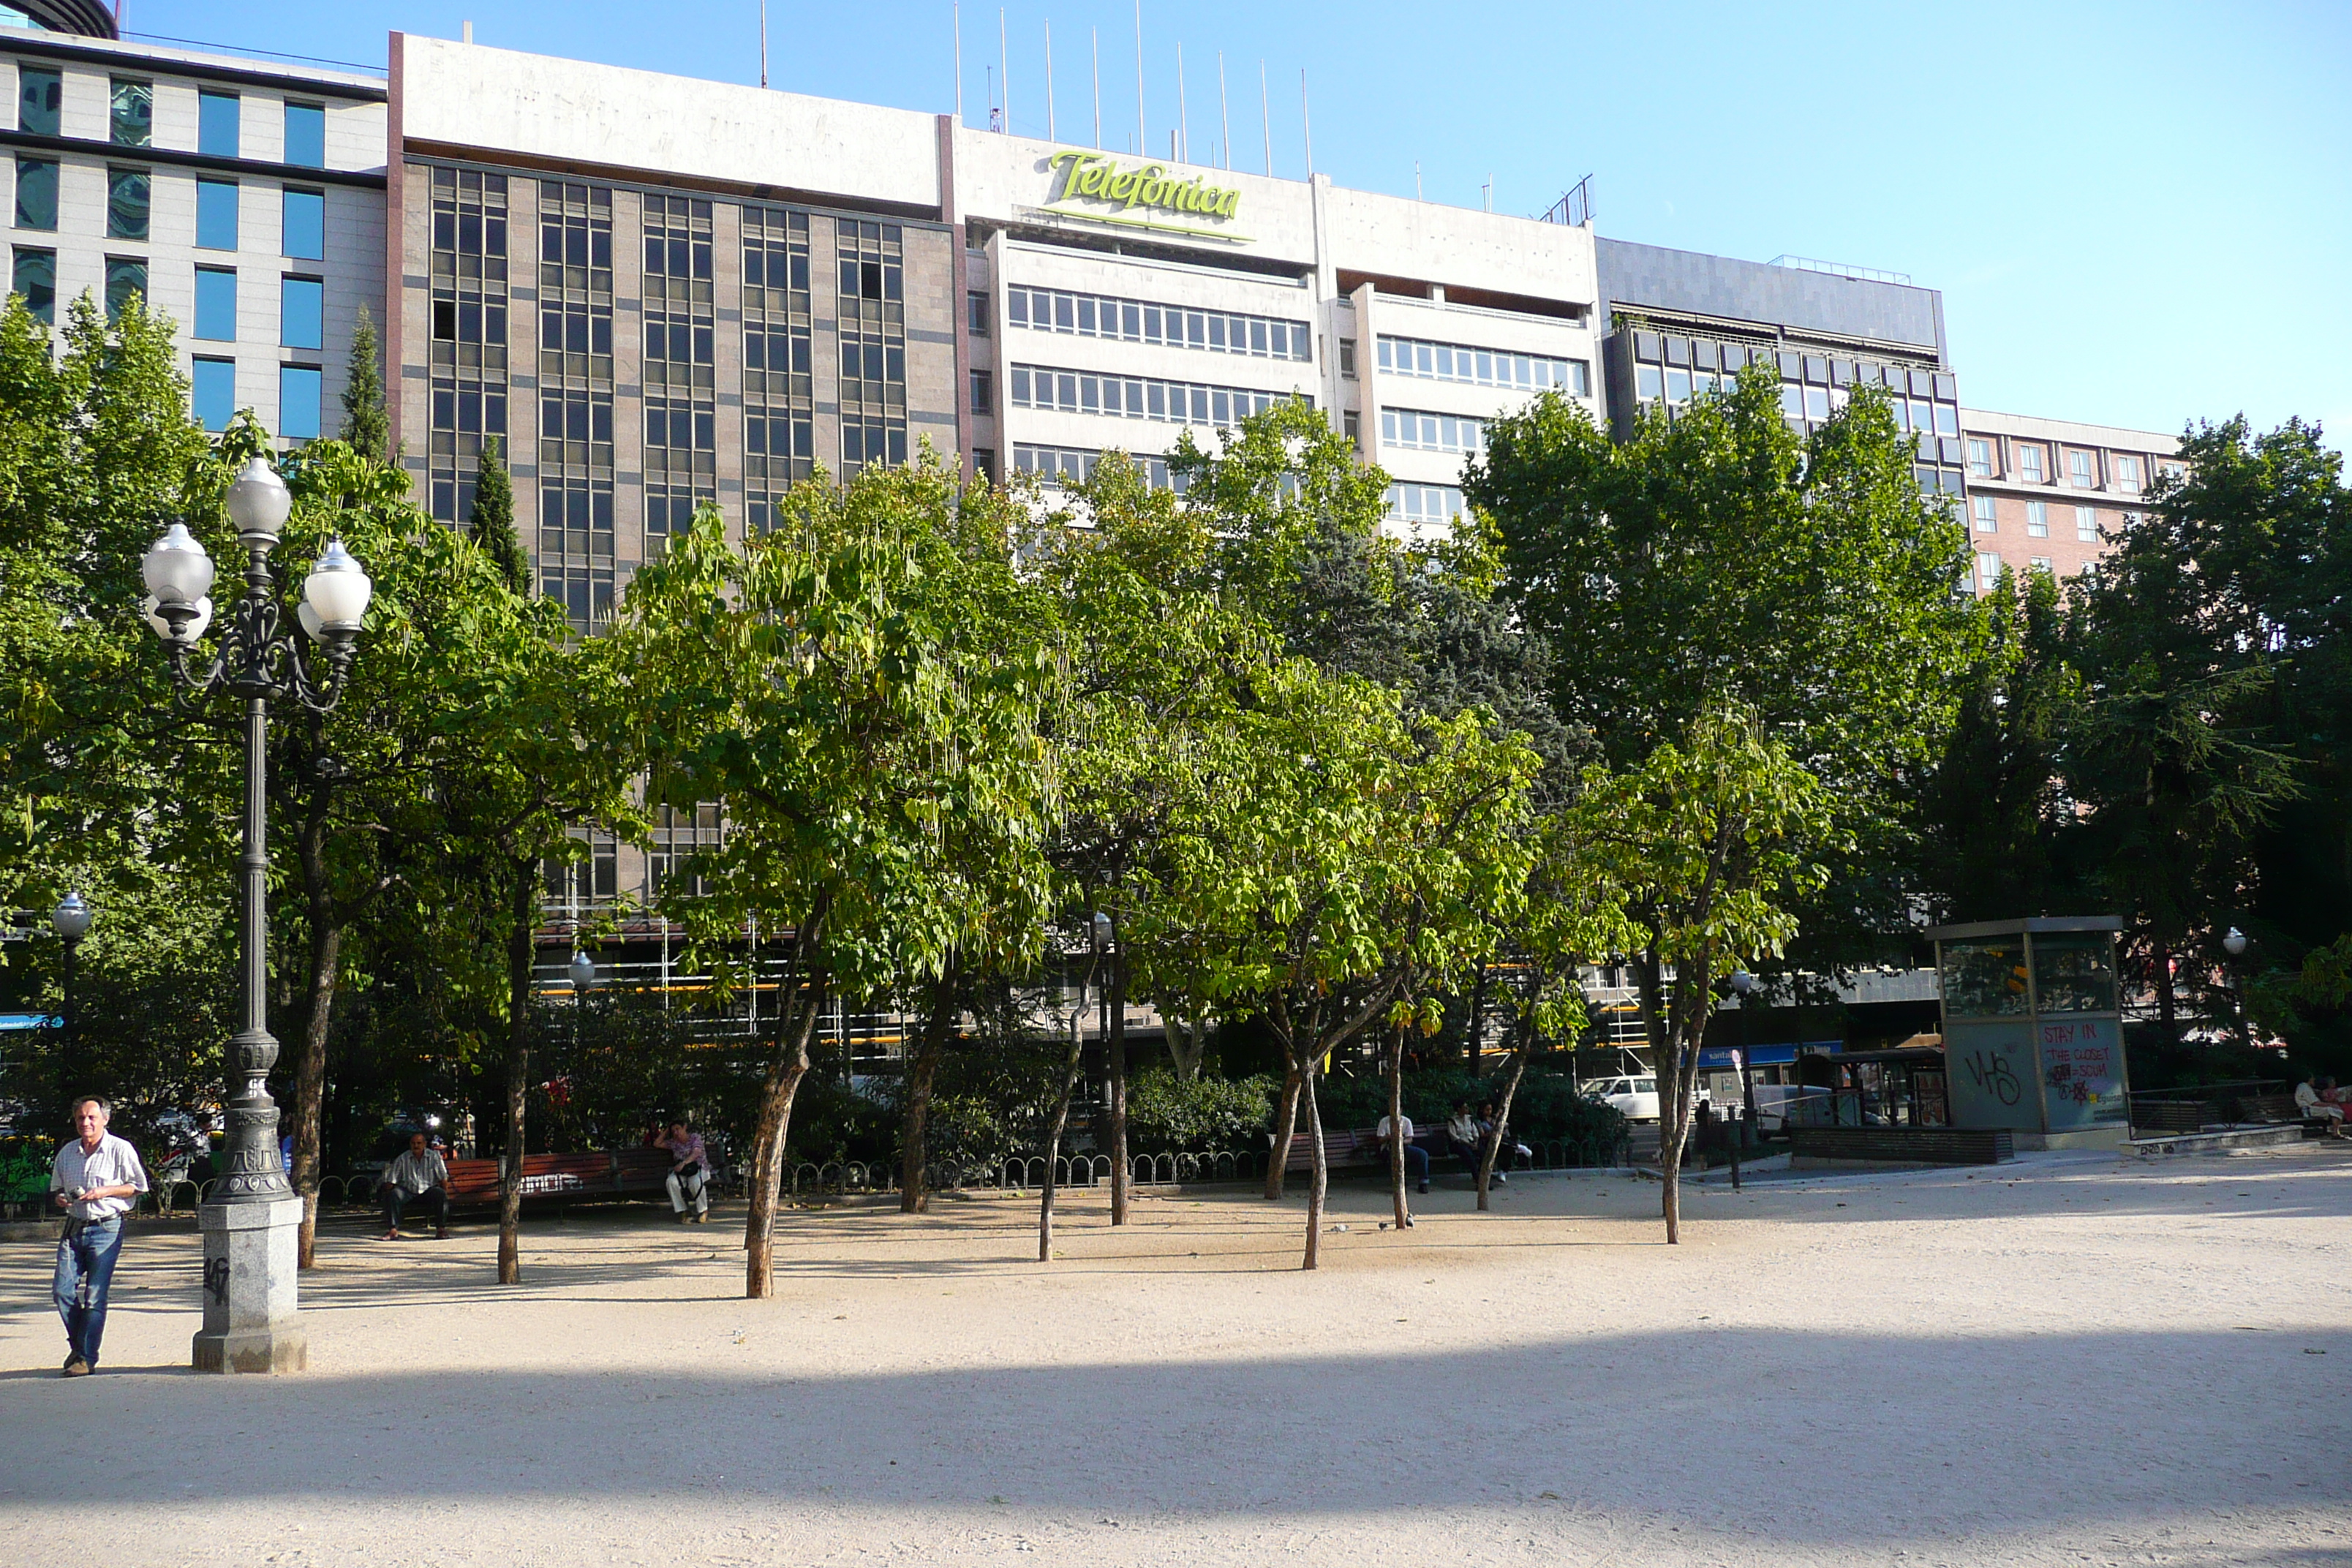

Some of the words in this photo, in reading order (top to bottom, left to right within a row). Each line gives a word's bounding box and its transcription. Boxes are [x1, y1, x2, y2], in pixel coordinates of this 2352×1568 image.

[2044, 1024, 2074, 1043] STAY
[2082, 1023, 2097, 1039] IN
[2046, 1048, 2070, 1062] THE
[2074, 1047, 2109, 1060] CLOSET
